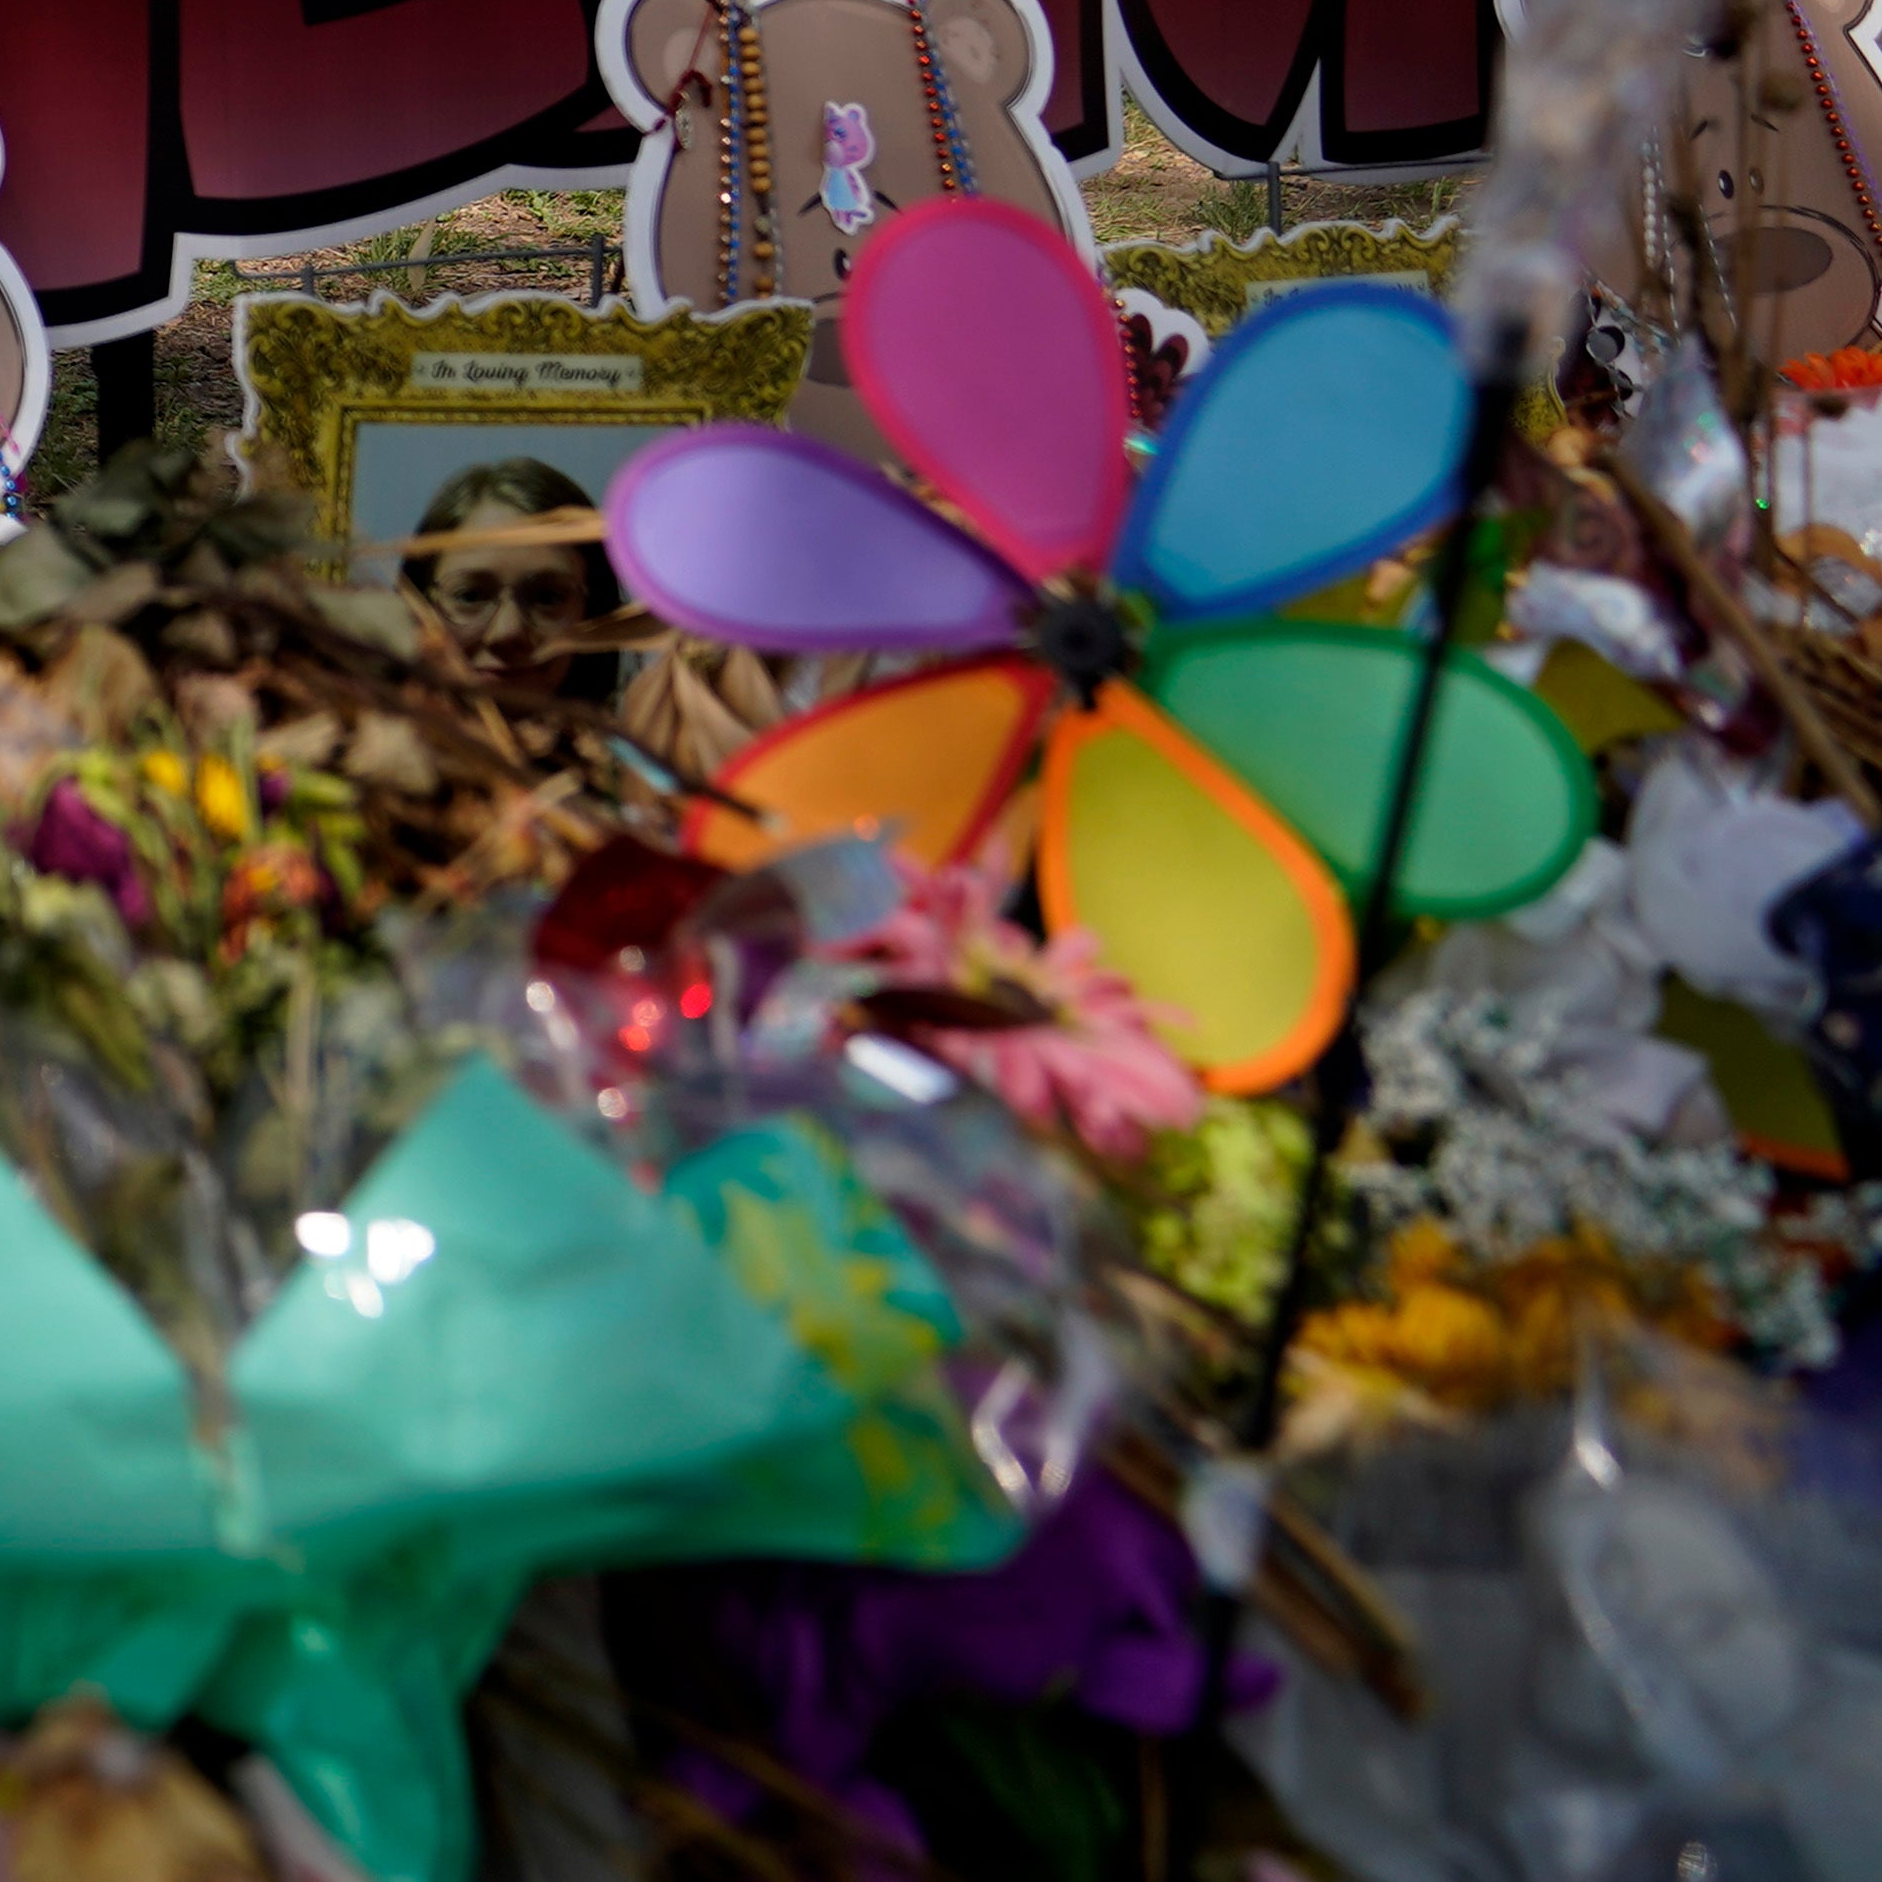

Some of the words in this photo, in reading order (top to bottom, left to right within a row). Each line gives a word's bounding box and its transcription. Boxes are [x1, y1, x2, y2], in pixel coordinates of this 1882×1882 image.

[431, 358, 456, 379] In
[463, 357, 530, 387] Loving
[536, 360, 623, 389] Memory
